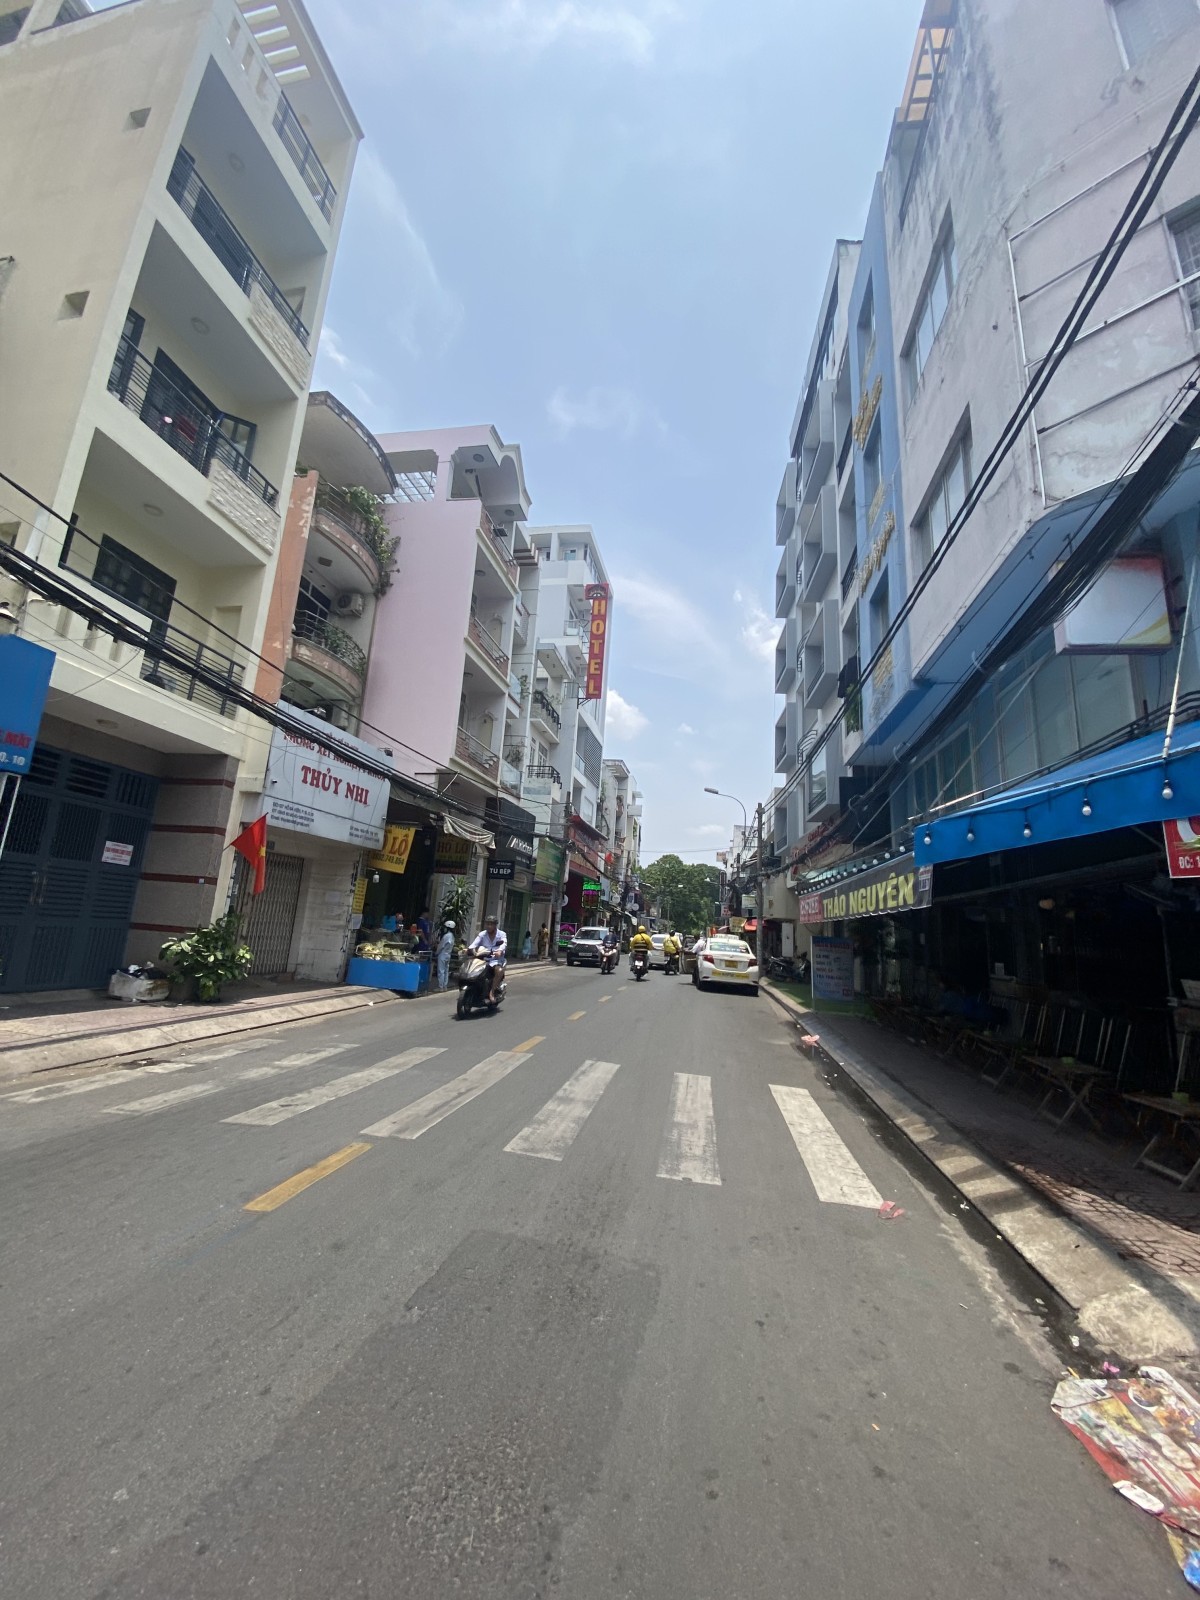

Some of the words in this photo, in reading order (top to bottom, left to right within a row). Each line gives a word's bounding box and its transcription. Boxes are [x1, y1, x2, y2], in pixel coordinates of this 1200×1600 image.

[588, 600, 606, 695] HOTEL
[12, 755, 25, 766] 10
[301, 765, 342, 795] THỦY
[1178, 856, 1194, 869] ĐC:
[823, 889, 845, 918] THẢO
[849, 872, 915, 915] NGUYÊN
